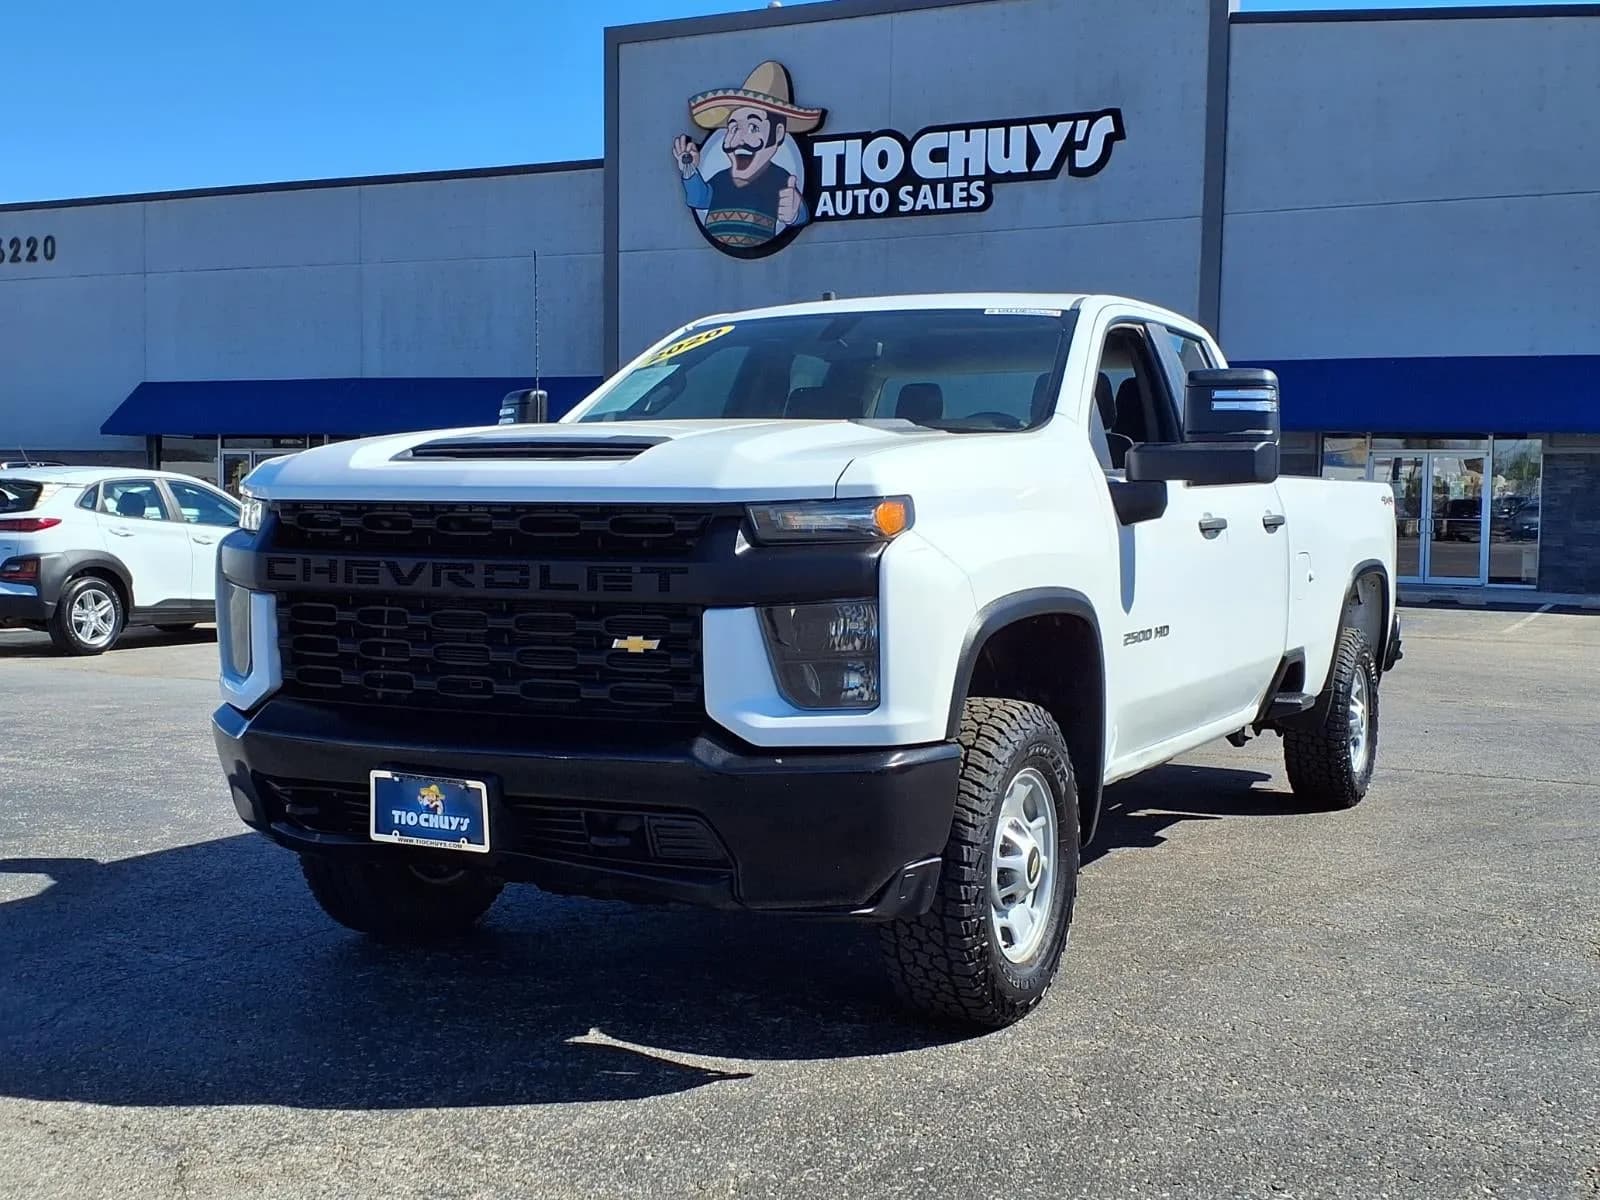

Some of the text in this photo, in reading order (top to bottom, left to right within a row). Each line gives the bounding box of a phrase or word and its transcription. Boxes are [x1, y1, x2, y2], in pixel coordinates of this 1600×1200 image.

[813, 115, 1115, 186] TIO CHUY'S
[815, 180, 985, 217] AUTO SALES
[266, 557, 689, 593] CHEVROLET
[1123, 625, 1170, 647] 2500 HD
[391, 809, 470, 831] TIO CHUY'S
